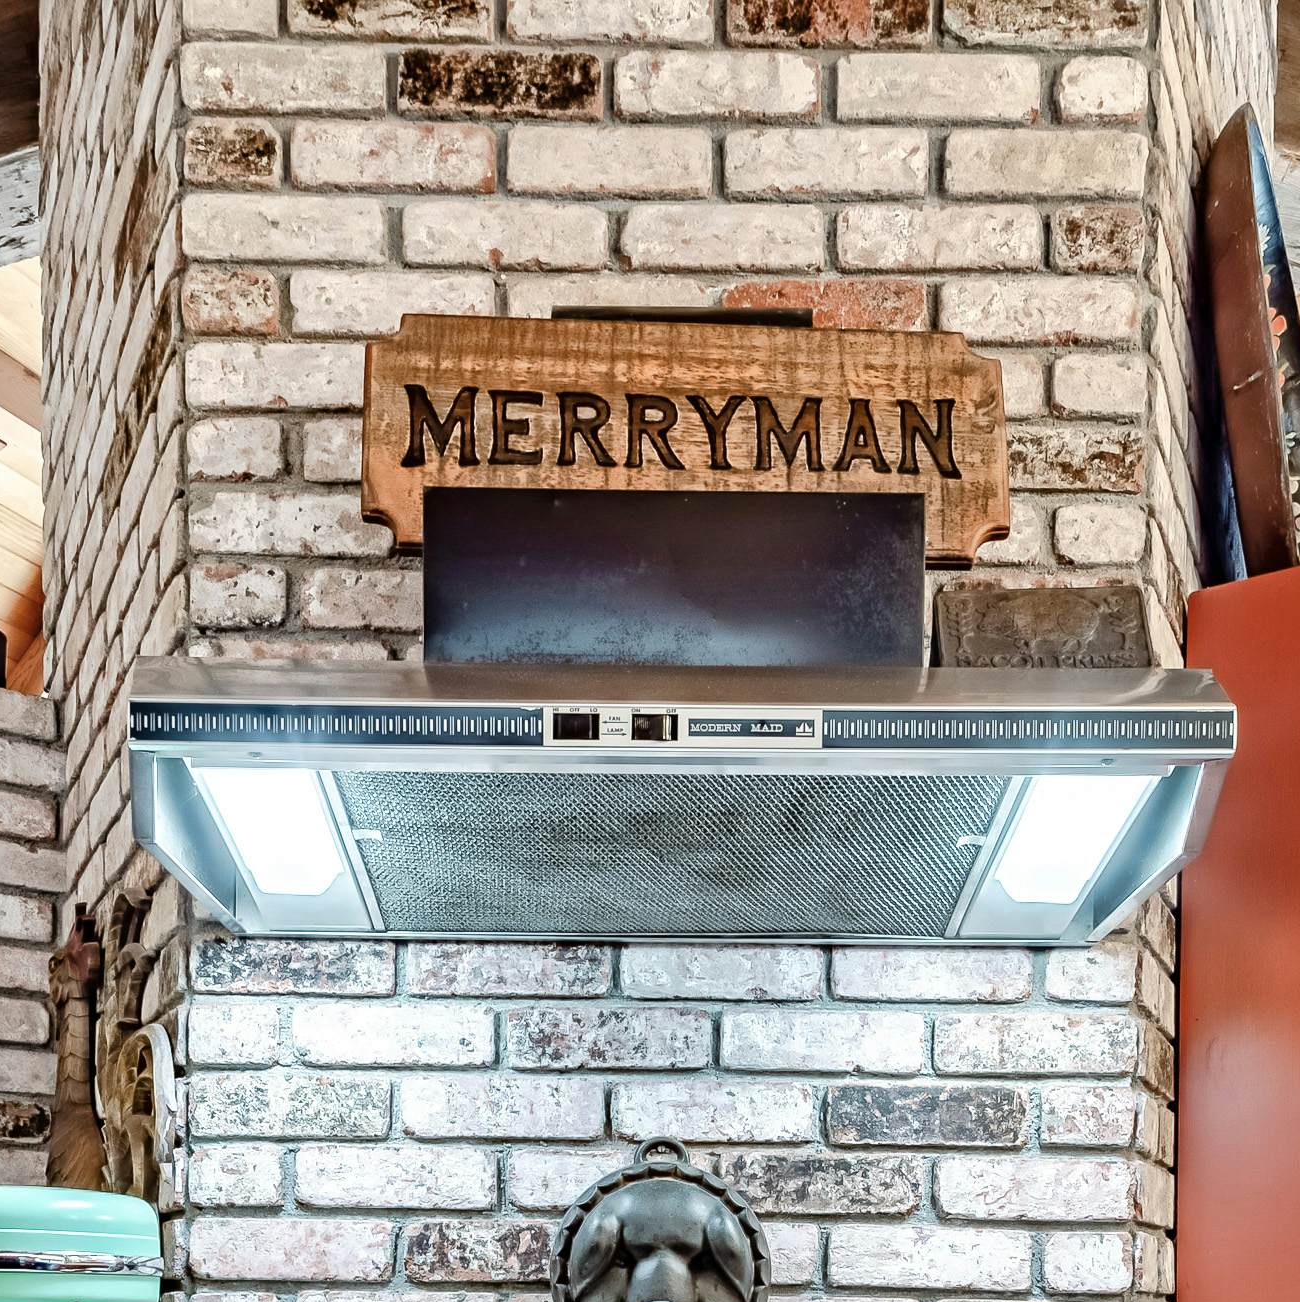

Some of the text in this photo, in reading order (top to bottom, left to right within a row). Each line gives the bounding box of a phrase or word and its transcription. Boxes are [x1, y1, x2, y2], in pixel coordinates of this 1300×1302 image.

[400, 383, 963, 480] MERRYMAN
[690, 723, 784, 733] MODERN MAID
